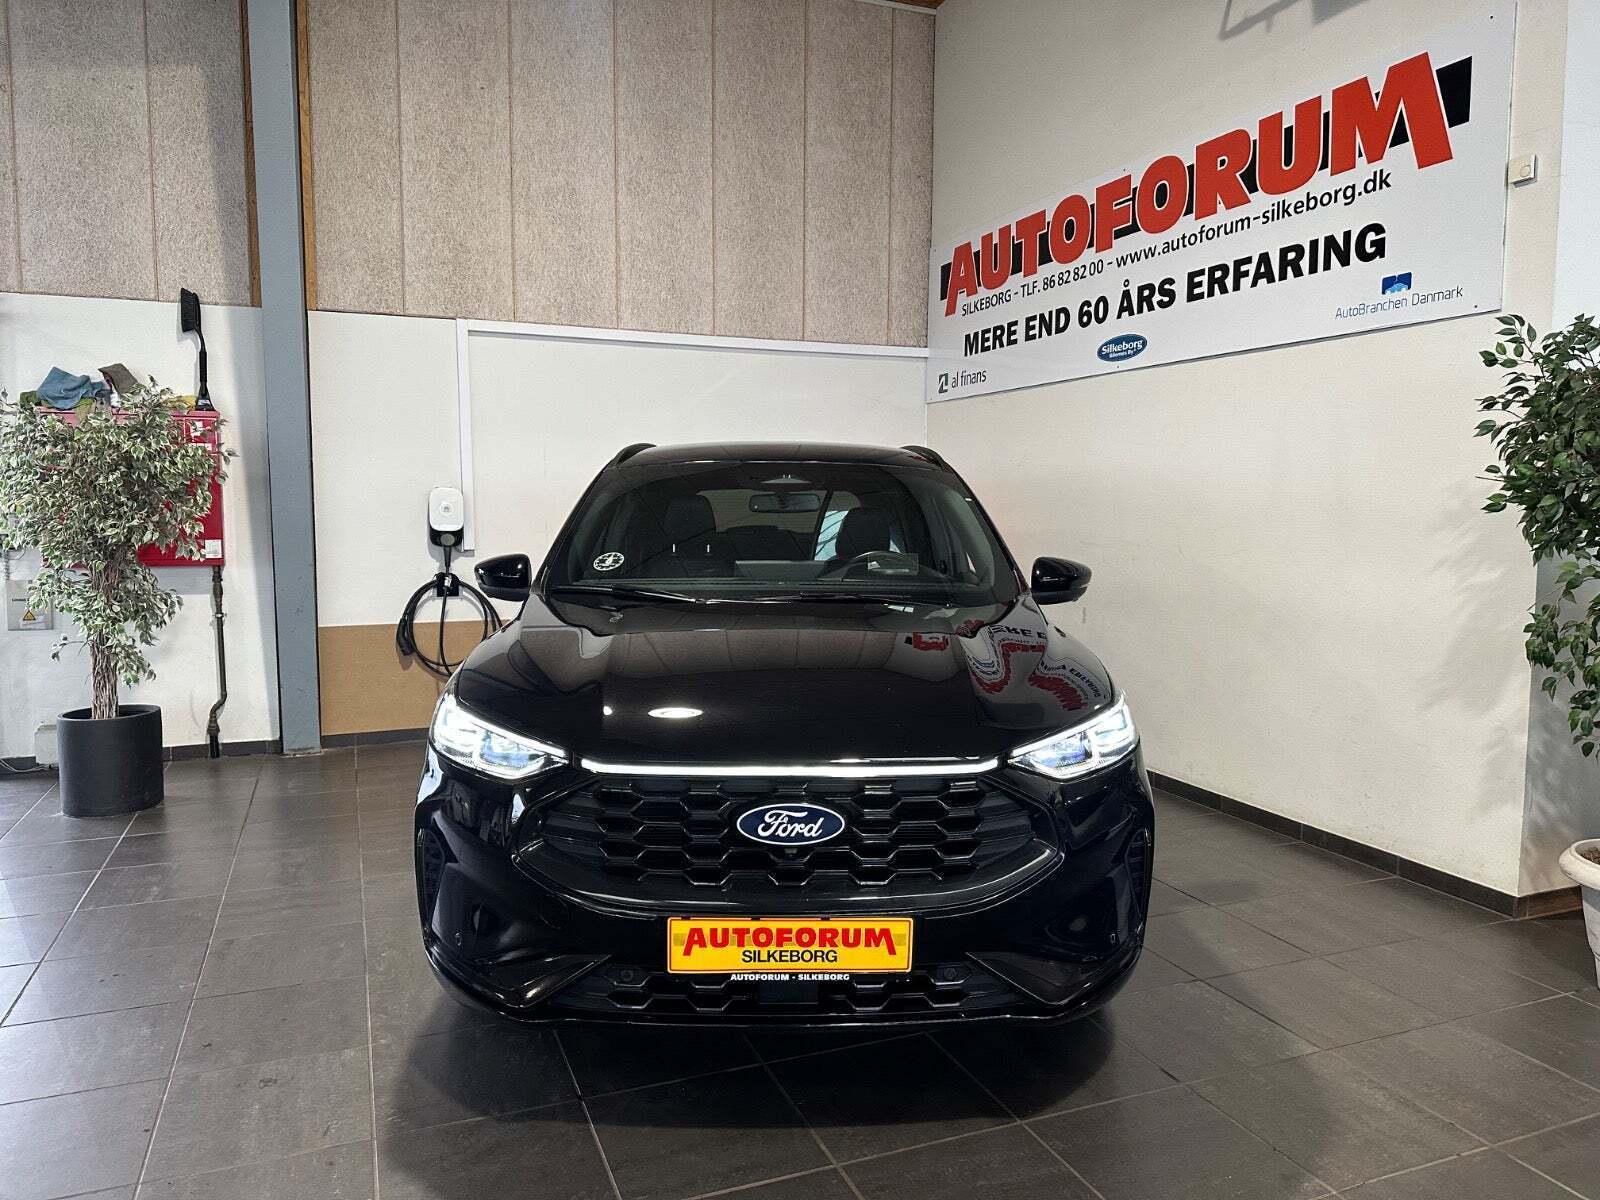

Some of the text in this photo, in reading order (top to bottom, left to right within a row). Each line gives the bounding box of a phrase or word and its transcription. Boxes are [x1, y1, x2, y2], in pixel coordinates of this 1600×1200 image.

[944, 51, 1453, 317] AUTOFORUM
[961, 289, 1012, 317] SILKEBORG
[1020, 280, 1041, 298] TLF.
[1115, 169, 1392, 267] www.autoforum-silkeborg.dk
[963, 222, 1387, 357] MERE END 60 ÅRS ERFARING
[1335, 285, 1464, 319] AutoBranchen Danmark
[1101, 340, 1144, 355] Silkeborg
[951, 370, 987, 389] al finans
[757, 809, 825, 837] Ford
[683, 927, 897, 956] AUTOFORUM
[741, 950, 838, 963] SILKEBORG
[730, 973, 790, 981] AUTOFORUM
[797, 973, 850, 981] SILKEBORG
